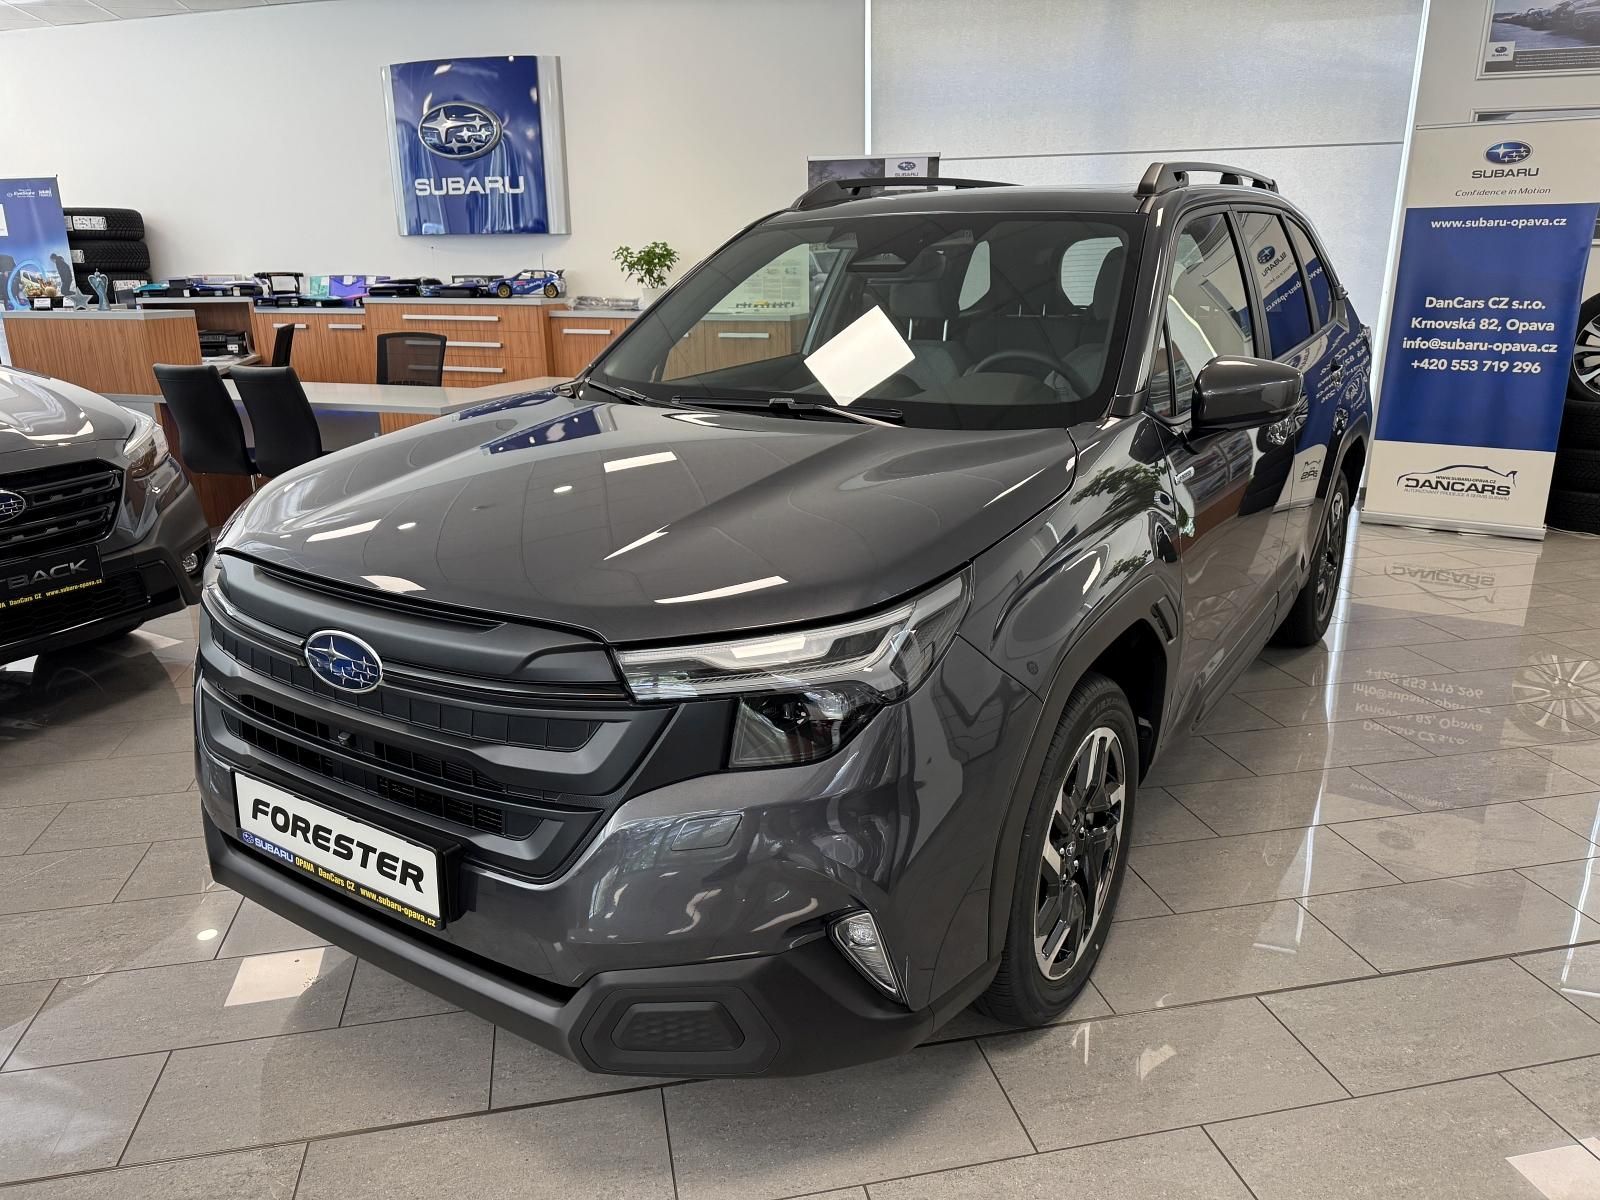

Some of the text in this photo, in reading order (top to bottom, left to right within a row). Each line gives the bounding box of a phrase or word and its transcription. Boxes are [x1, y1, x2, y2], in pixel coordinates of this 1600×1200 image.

[1471, 168, 1540, 179] SUBARU
[414, 175, 525, 196] SUBARU
[1455, 188, 1507, 197] Confidence
[1518, 186, 1551, 195] Motion
[1431, 217, 1567, 229] www.subaru-opava.cz
[1425, 297, 1546, 309] DanCars CZ s.r.o.
[1411, 317, 1555, 334] Krnovská 82, Opava
[1402, 337, 1558, 354] info@subaru-opava.cz
[1411, 359, 1541, 374] +420 553 719 296
[1404, 478, 1511, 496] DANCARS
[9, 595, 33, 606] DanCars
[34, 592, 42, 600] CZ
[252, 798, 424, 893] FORESTER
[254, 837, 436, 928] SUBARU OPAVA DanCars CZ www.subaru-opava.cz
